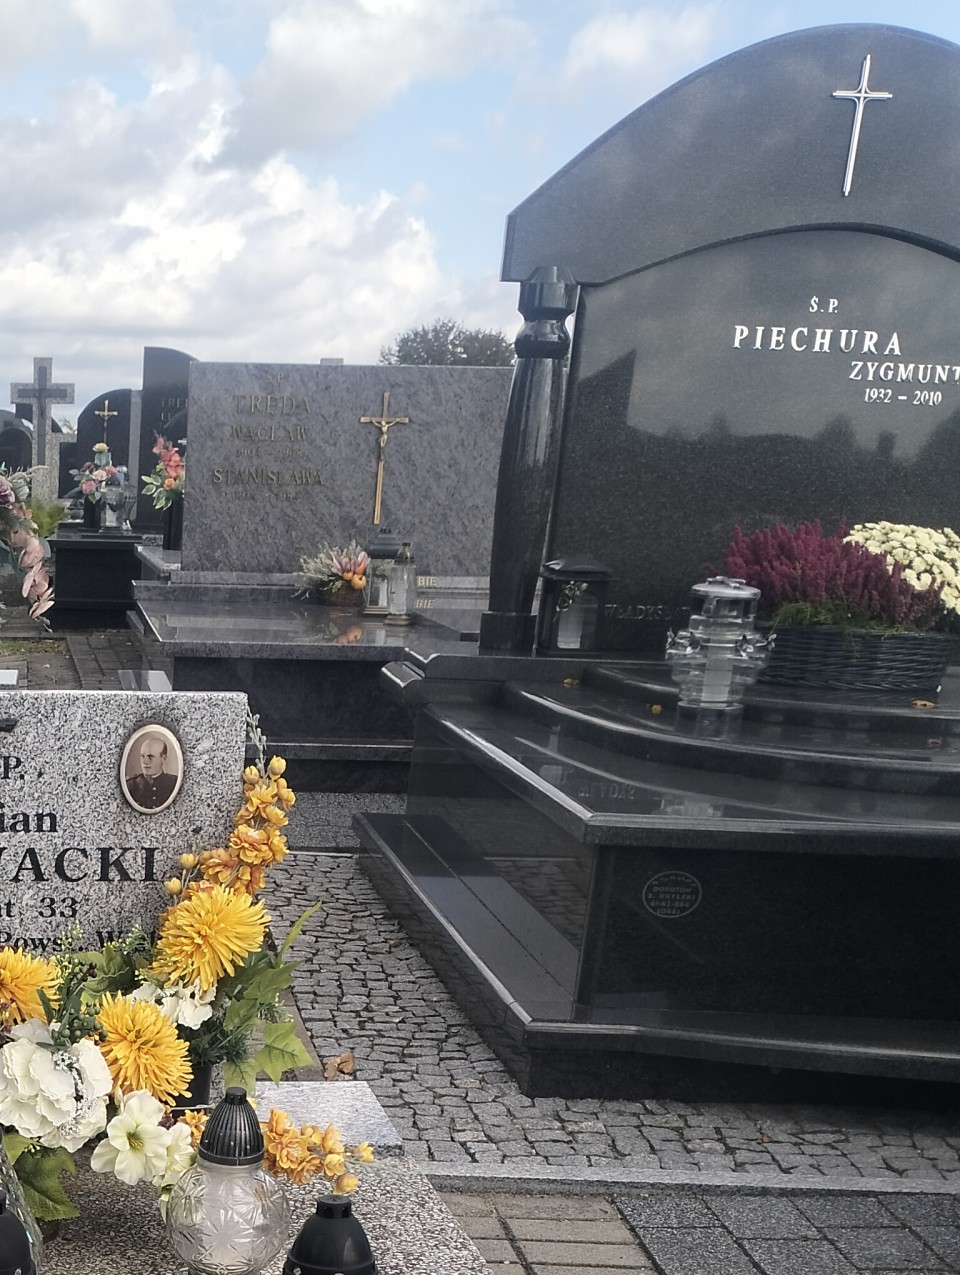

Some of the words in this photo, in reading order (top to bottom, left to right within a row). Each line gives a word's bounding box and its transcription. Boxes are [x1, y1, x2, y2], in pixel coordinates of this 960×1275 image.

[732, 325, 902, 356] PIECHURA
[864, 388, 892, 403] 1932
[912, 390, 942, 406] 2010
[417, 576, 437, 586] BIE
[39, 896, 78, 919] 33
